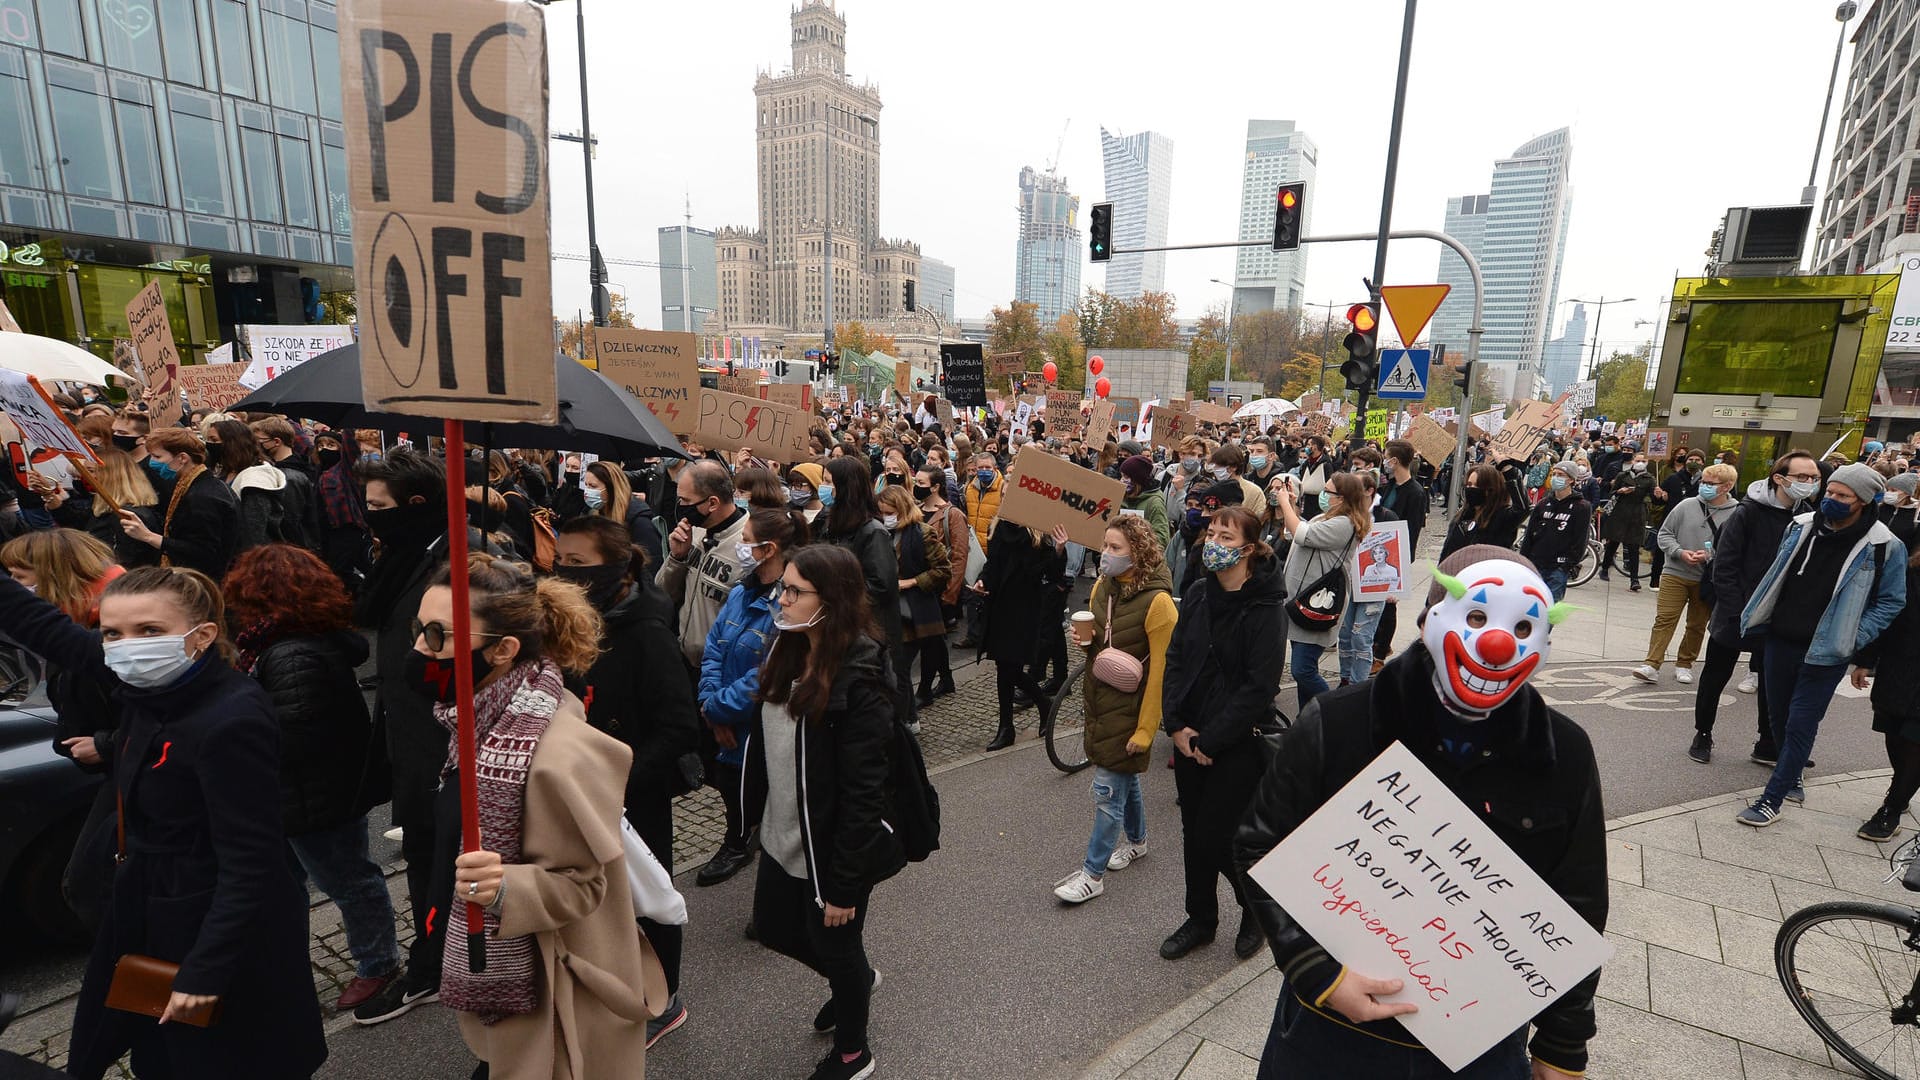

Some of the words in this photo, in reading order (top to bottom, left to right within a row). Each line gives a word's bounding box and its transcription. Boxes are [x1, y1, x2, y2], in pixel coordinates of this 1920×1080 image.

[360, 22, 539, 215] PIS
[371, 212, 525, 395] OFF
[265, 337, 306, 349] SZKODA
[1889, 331, 1910, 343] 22
[264, 351, 280, 361] TO
[285, 351, 303, 361] NIE
[182, 375, 197, 388] NIE
[757, 407, 793, 448] OFF
[1055, 409, 1069, 417] FUN
[1508, 424, 1547, 454] OFF
[1557, 521, 1568, 531] 3
[1377, 770, 1418, 815] ALL
[1431, 822, 1451, 838] I
[1449, 837, 1514, 896] HAVE
[1520, 911, 1573, 953] ARE
[1334, 838, 1414, 902] ABOUT
[1421, 916, 1475, 961] PIS
[1357, 800, 1471, 907] NEGATIVE
[1473, 909, 1558, 1000] THOUGHTS
